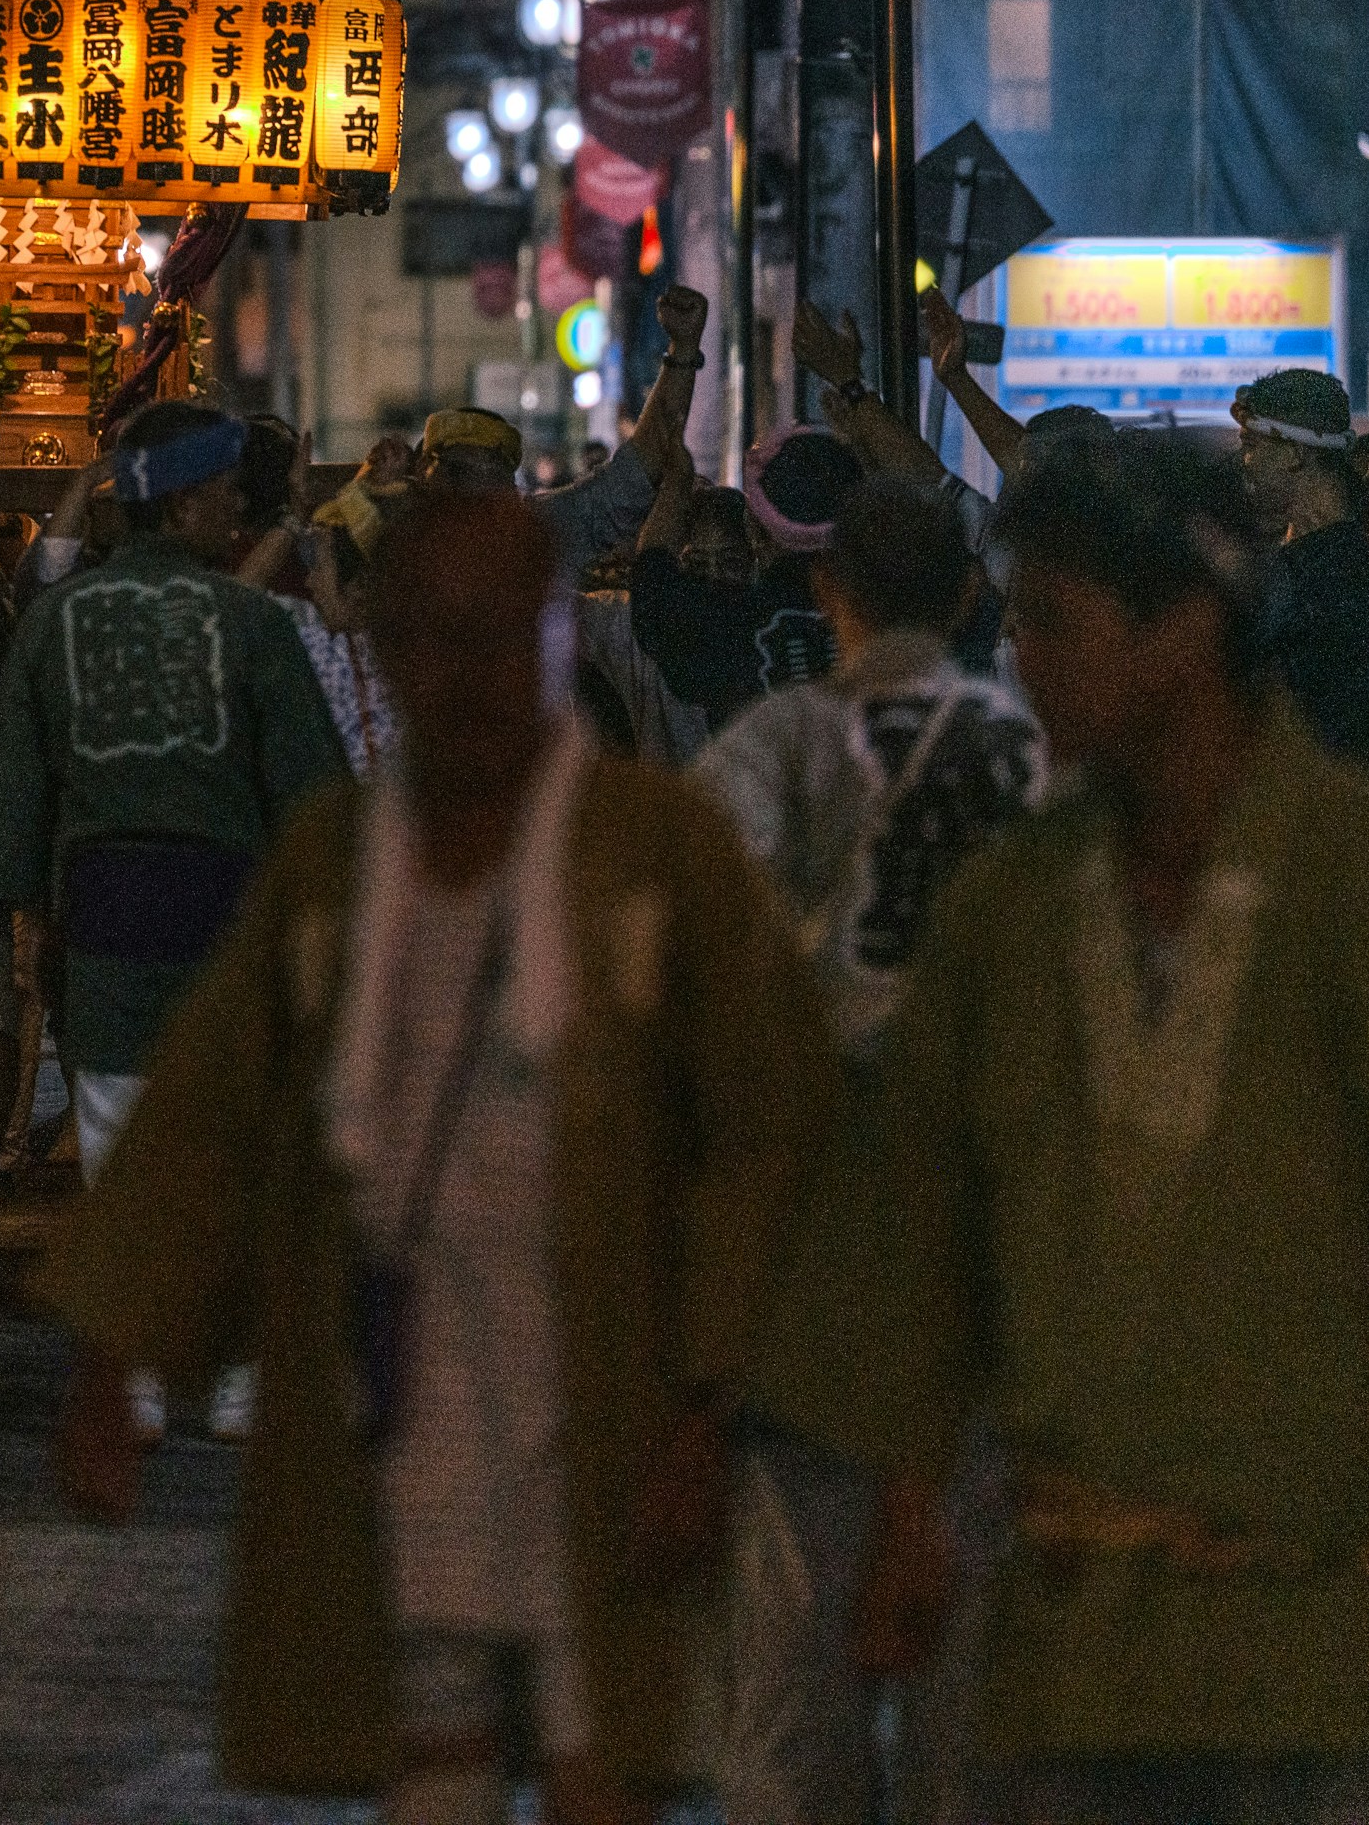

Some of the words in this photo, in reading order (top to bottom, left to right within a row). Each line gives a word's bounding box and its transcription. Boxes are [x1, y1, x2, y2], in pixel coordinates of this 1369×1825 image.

[139, 0, 189, 153] 富岡睦
[199, 4, 244, 151] とまり木
[262, 1, 317, 29] 中華
[257, 29, 311, 162] 紀龍
[341, 49, 383, 159] 西部
